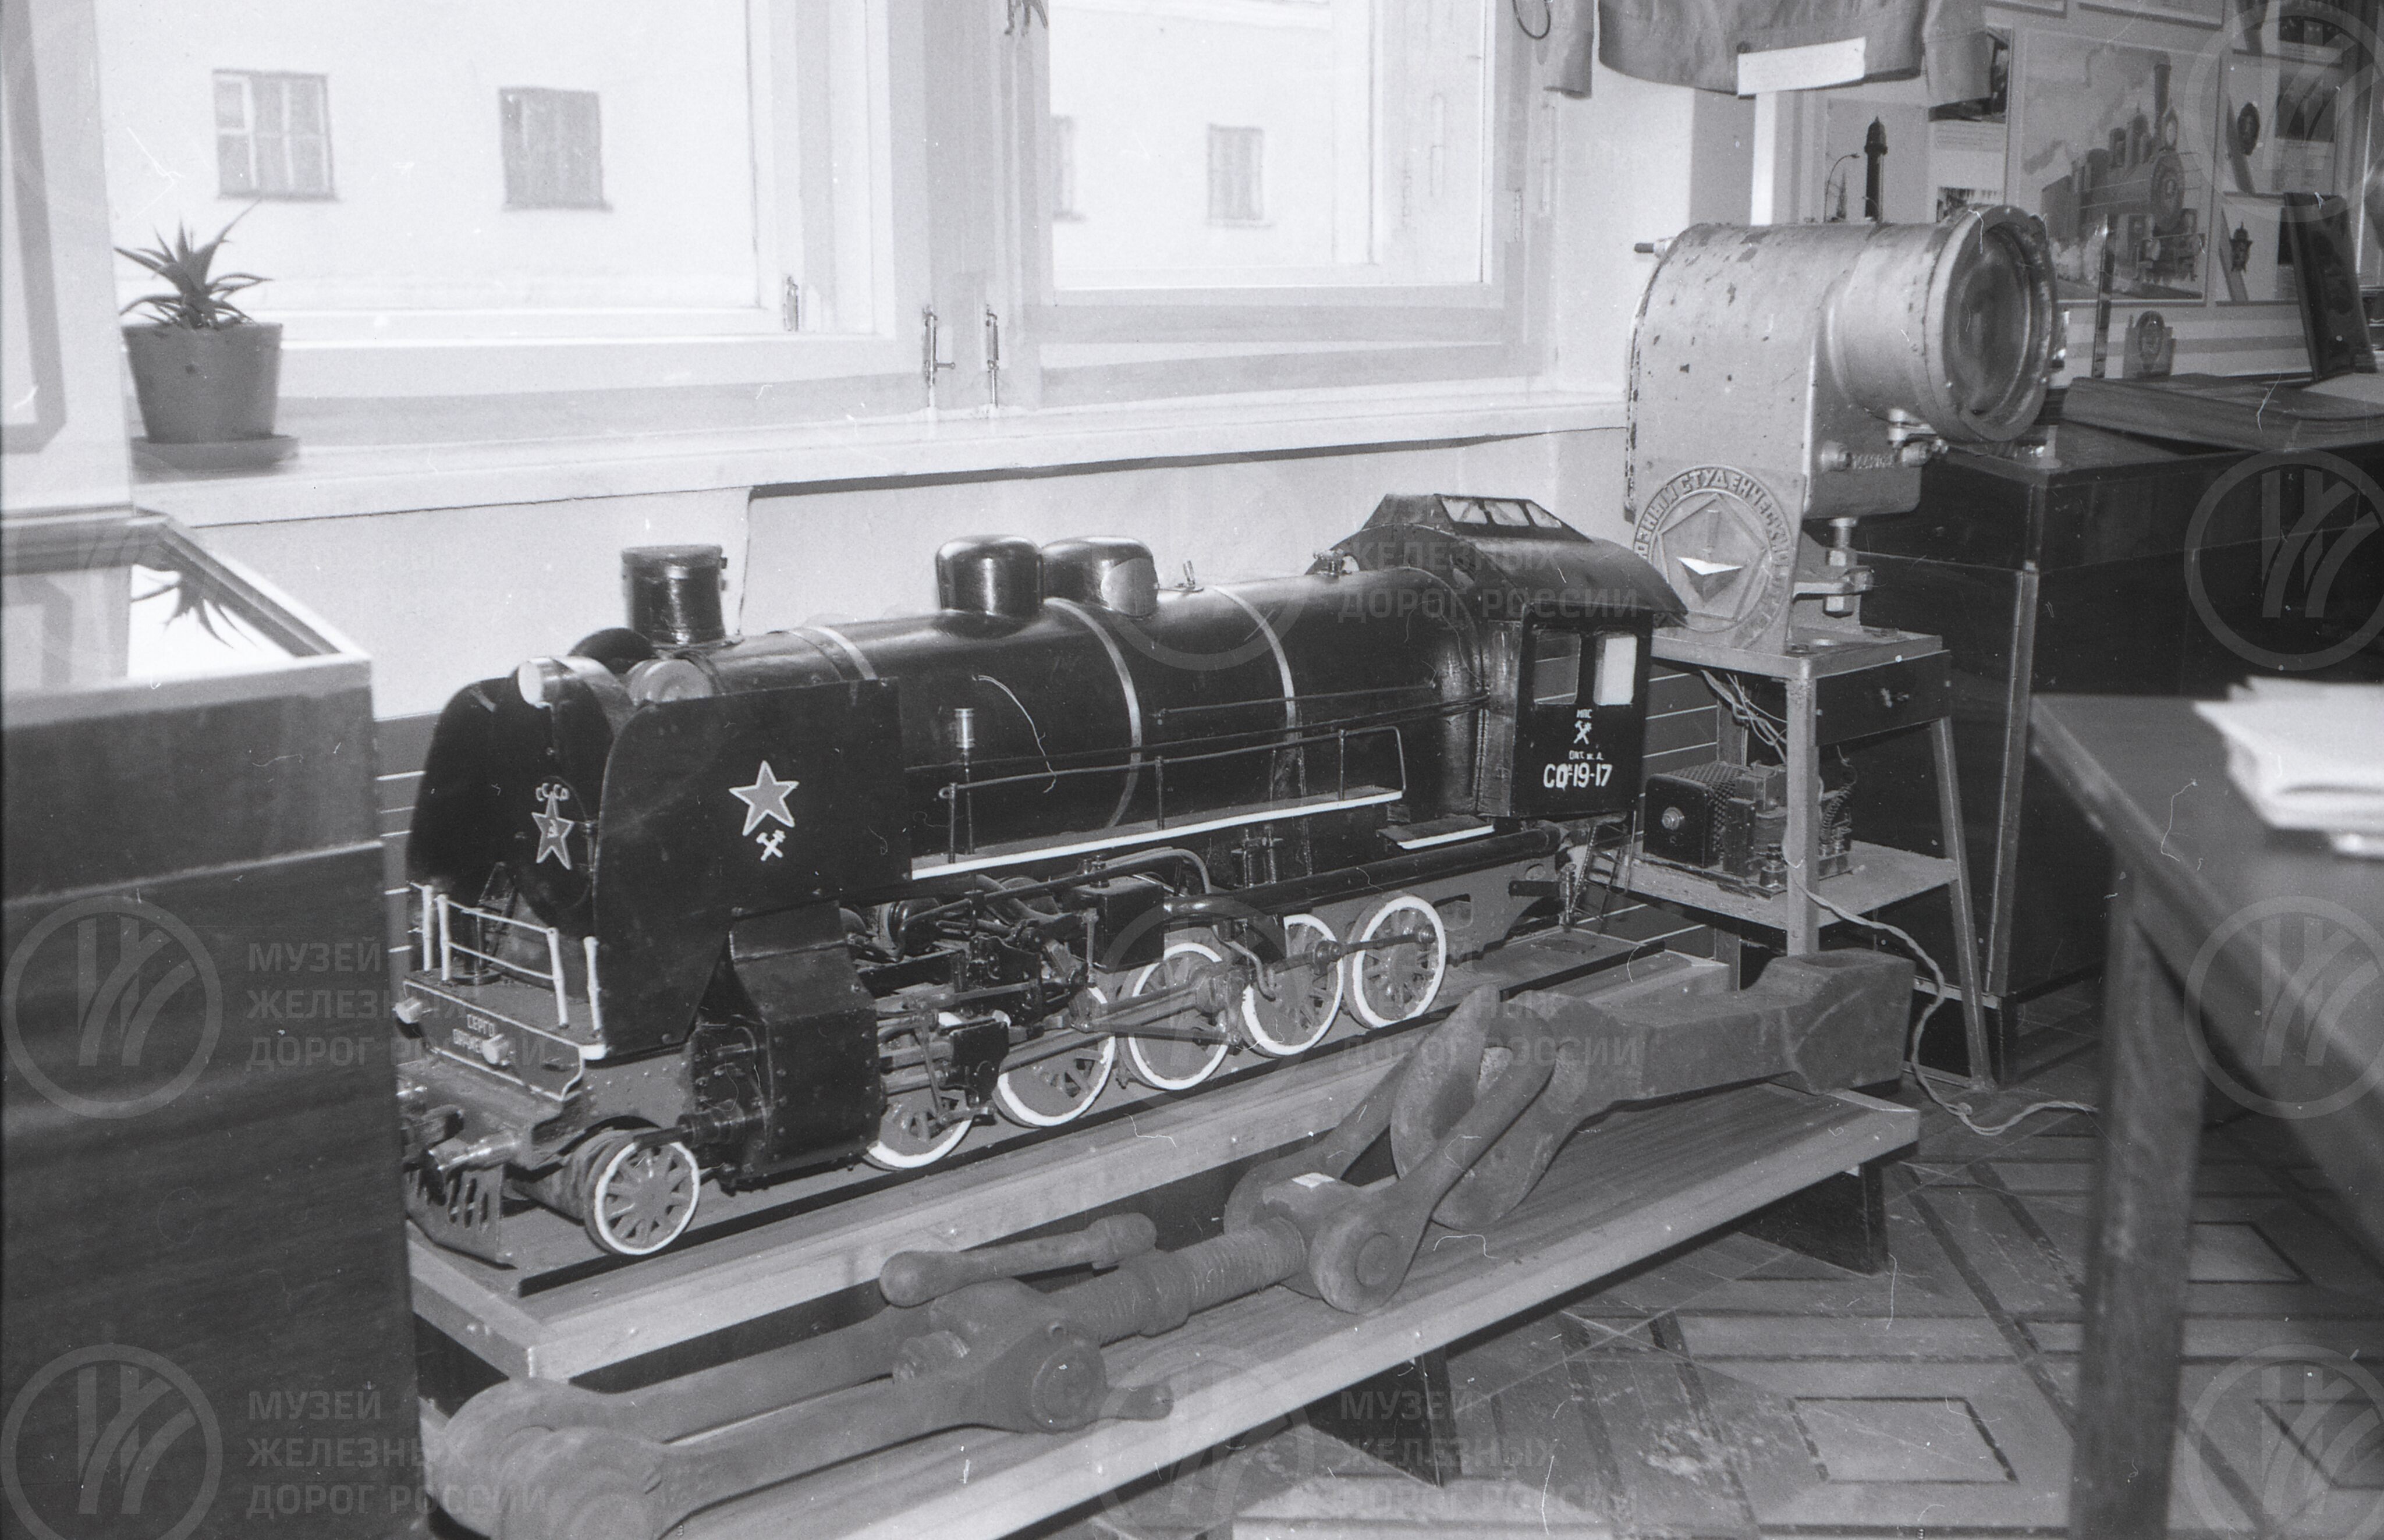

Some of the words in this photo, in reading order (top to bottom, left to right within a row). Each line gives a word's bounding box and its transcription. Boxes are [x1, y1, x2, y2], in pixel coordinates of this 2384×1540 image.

[1576, 709, 1593, 719] МПС
[535, 782, 571, 802] СССР
[467, 1014, 496, 1037] СЕРГО
